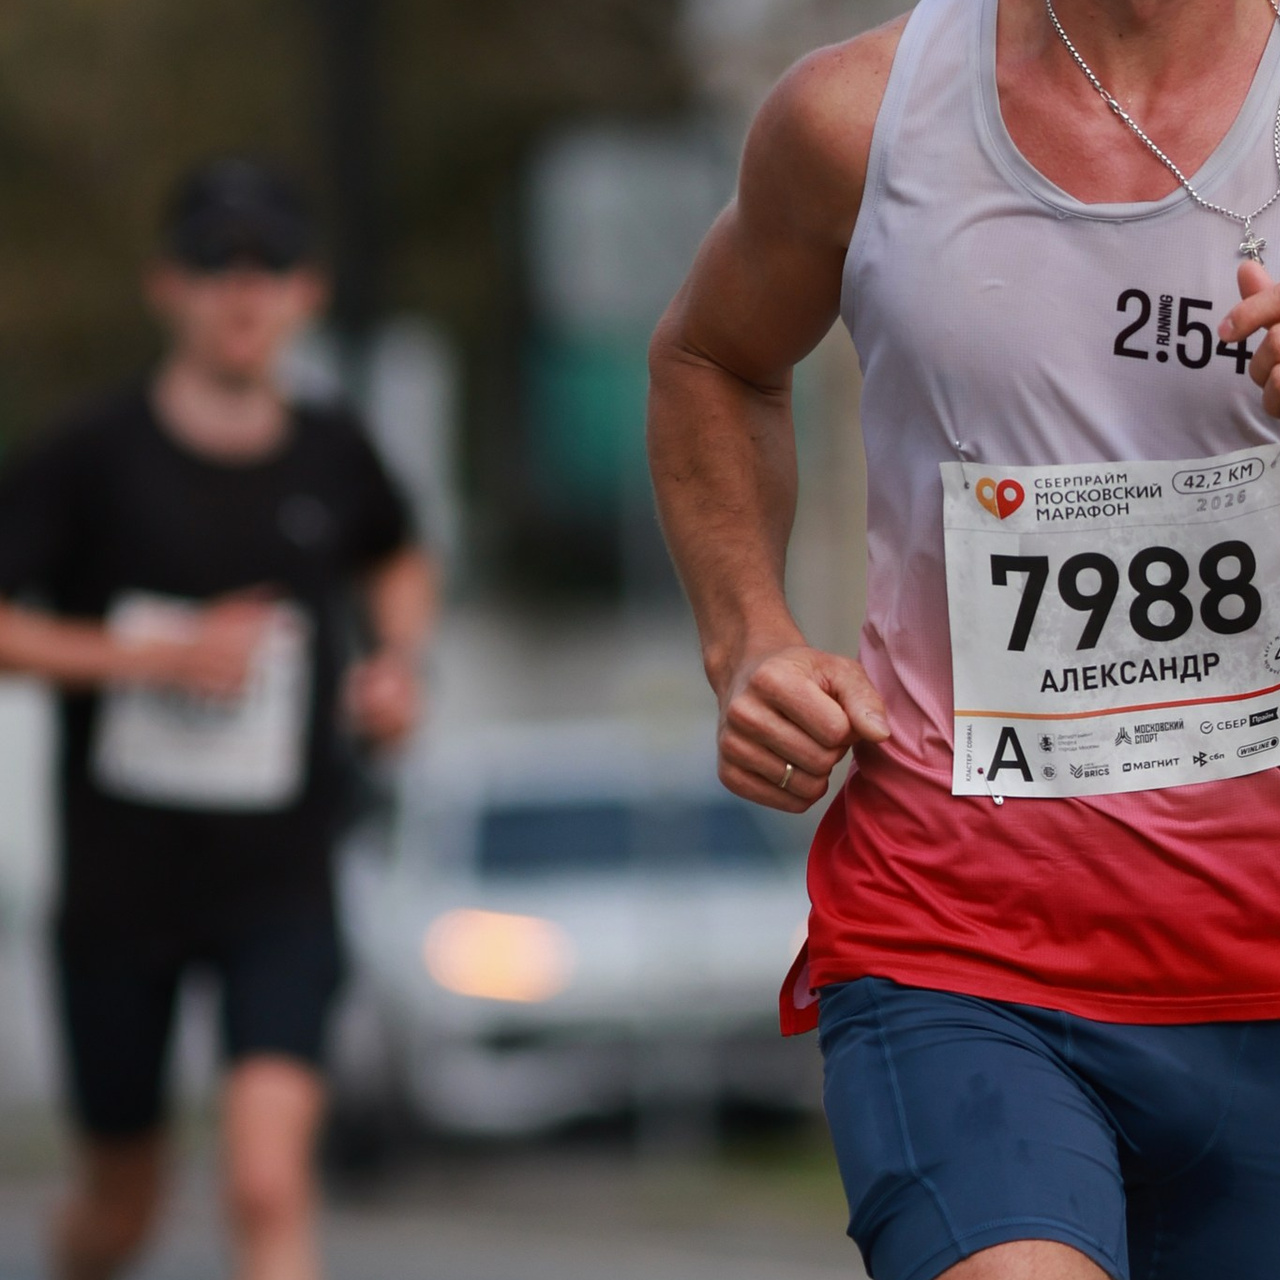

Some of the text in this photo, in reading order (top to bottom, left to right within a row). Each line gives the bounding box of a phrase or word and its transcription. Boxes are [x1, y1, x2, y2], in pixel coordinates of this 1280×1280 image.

[1156, 294, 1173, 347] RUNNING
[1034, 473, 1127, 489] СБЕРПРАЙМ
[1183, 471, 1221, 489] 42,2
[1035, 483, 1162, 505] МОСКОВСКИЙ
[1196, 489, 1247, 512] 2026
[1036, 502, 1130, 521] МАРАФОН
[990, 540, 1262, 652] 7988
[1040, 652, 1220, 693] АЛЕКСАНДР
[1134, 717, 1184, 734] МОСКОВСКИЙ
[1216, 718, 1247, 730] СБЕР
[1135, 733, 1158, 745] СПОРТ
[1240, 741, 1270, 755] WINLINE
[1084, 768, 1110, 778] BRICS
